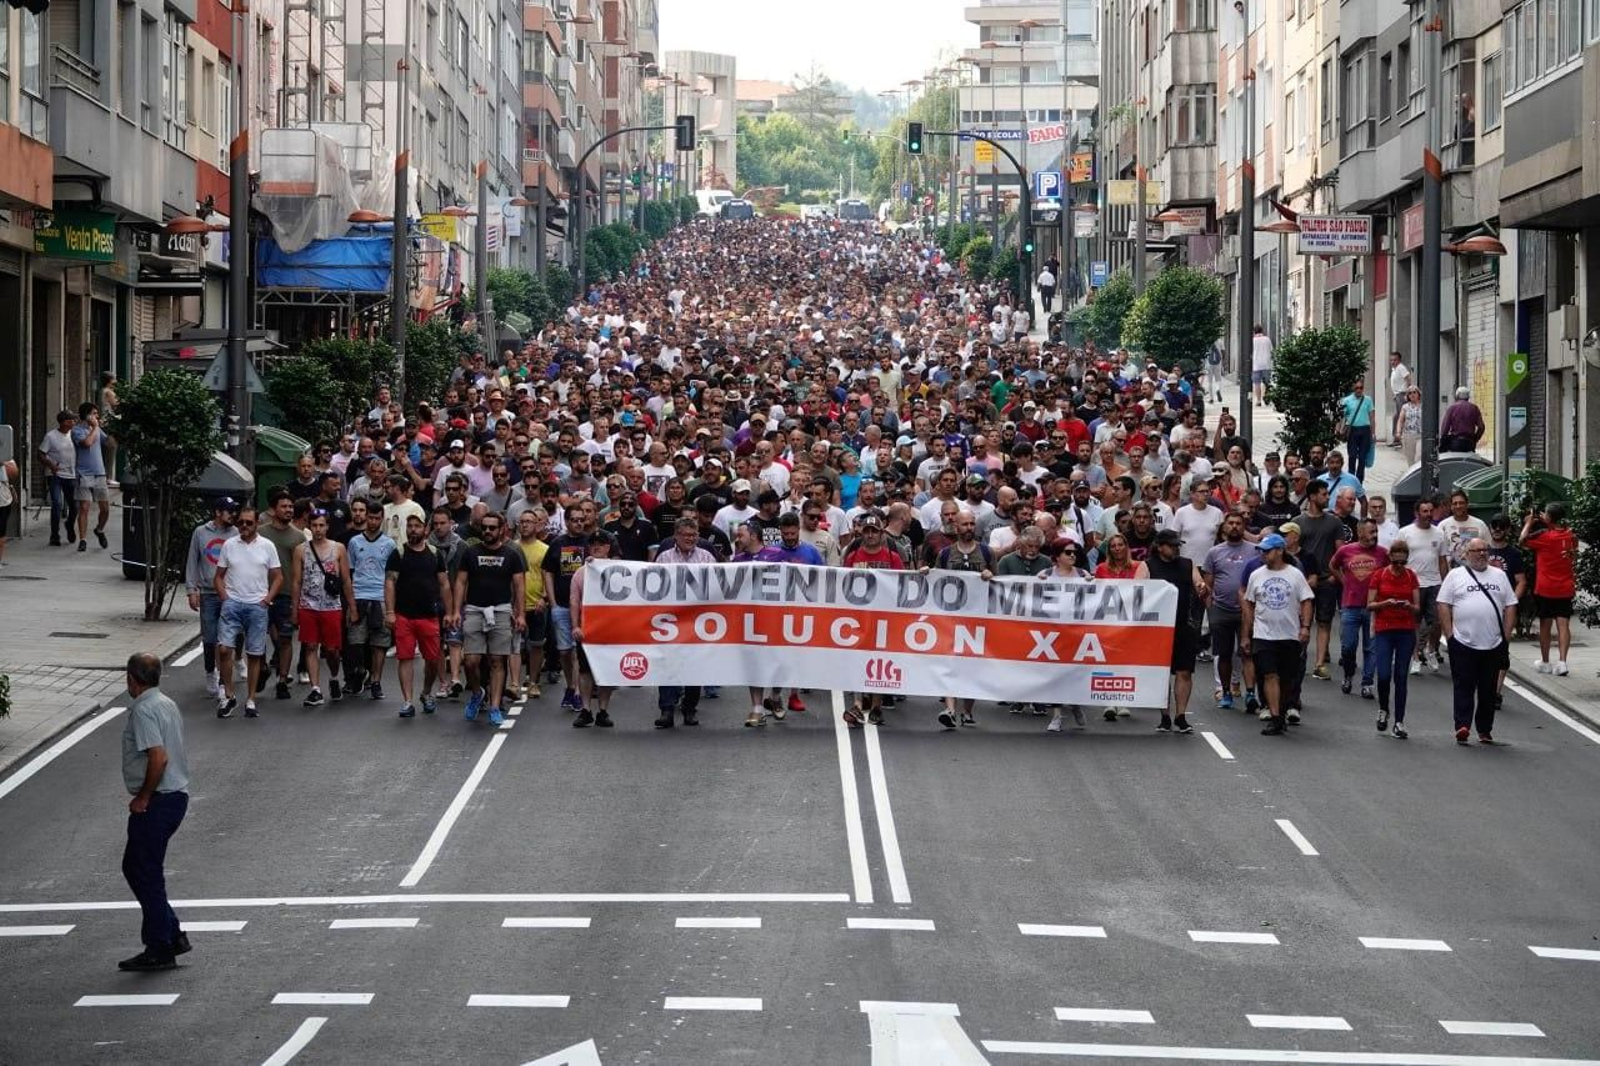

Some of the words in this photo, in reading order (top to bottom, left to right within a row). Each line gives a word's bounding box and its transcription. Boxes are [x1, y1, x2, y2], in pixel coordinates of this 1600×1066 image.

[1029, 126, 1065, 143] FARO
[1040, 174, 1057, 196] P
[64, 225, 91, 251] Venta
[92, 228, 114, 254] Press
[600, 564, 878, 605] CONVENIO
[897, 572, 968, 612] DO
[987, 580, 1160, 622] METAL
[1467, 583, 1500, 592] addas
[650, 612, 985, 656] SOLUCIÓN
[623, 656, 644, 668] UGT
[866, 658, 901, 681] CIG
[1094, 679, 1132, 690] CCOO
[1091, 691, 1135, 701] industria
